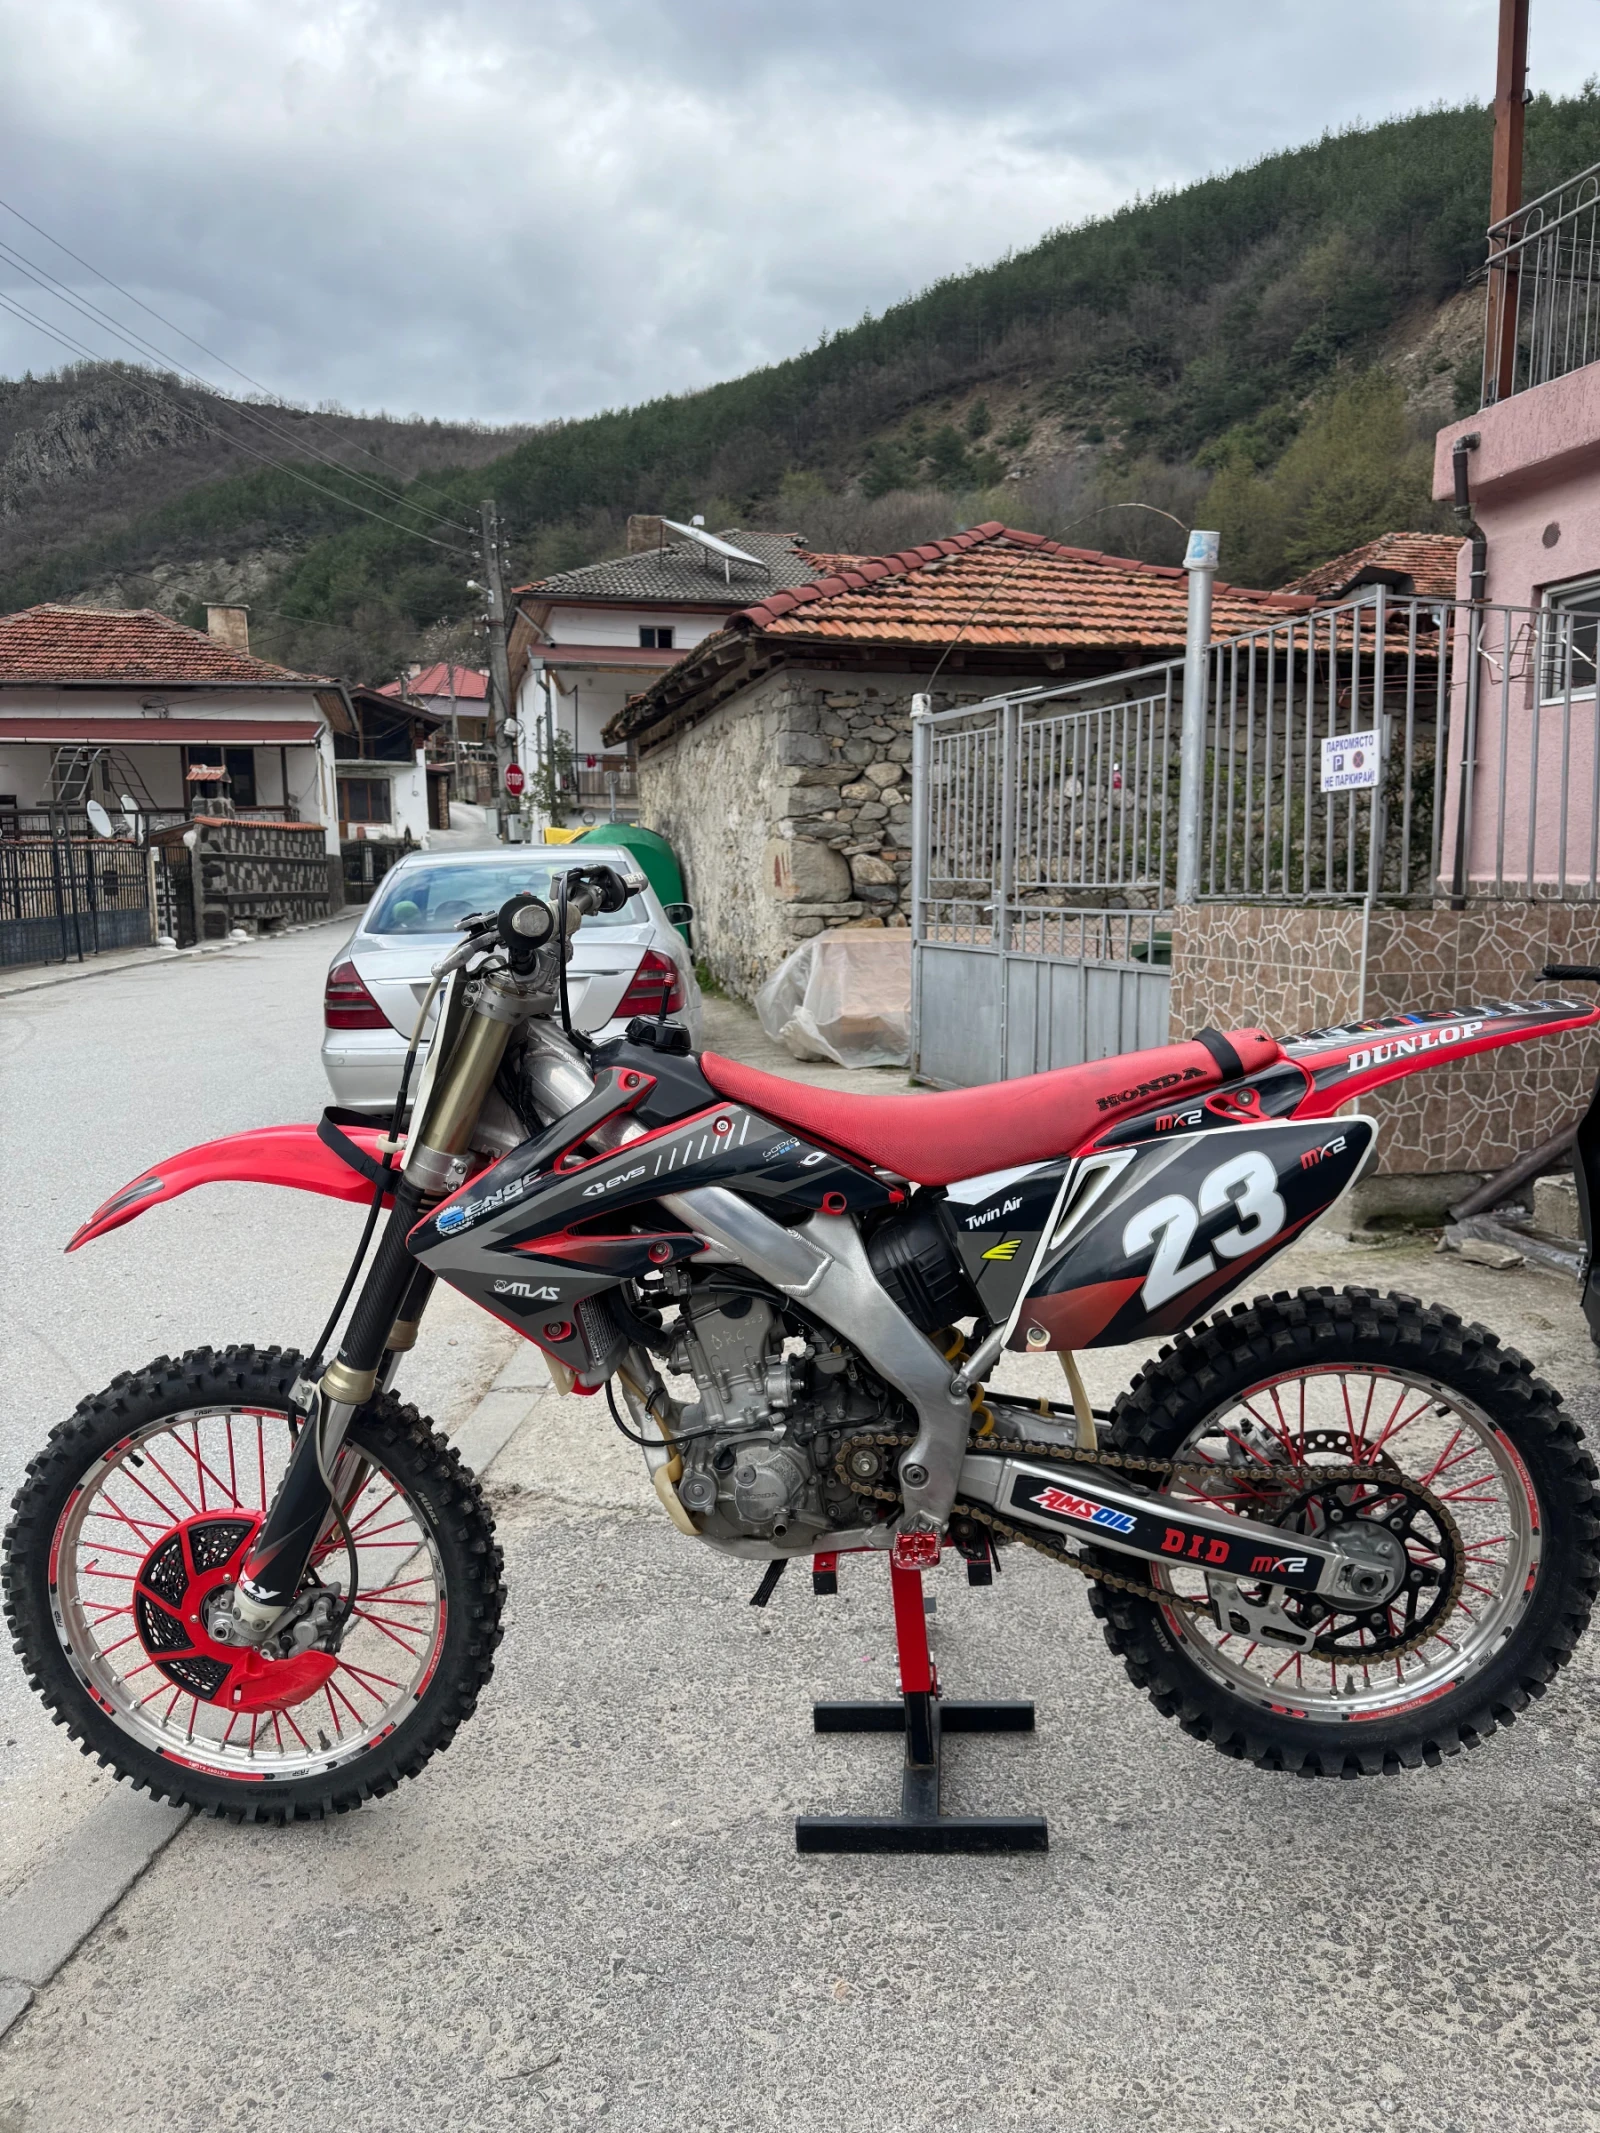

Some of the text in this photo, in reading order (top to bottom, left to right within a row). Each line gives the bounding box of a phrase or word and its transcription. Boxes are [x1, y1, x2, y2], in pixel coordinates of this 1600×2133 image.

[1326, 735, 1374, 753] ПАРКОМЯСТО
[507, 773, 522, 785] STOP
[1325, 776, 1334, 788] НЕ
[1347, 1021, 1484, 1074] DUNLOP
[1096, 1067, 1207, 1112] HONDA
[1155, 1109, 1202, 1132] MX2
[1300, 1136, 1347, 1170] MX2
[965, 1197, 1023, 1230] Twin Air
[1122, 1150, 1287, 1313] 23
[502, 1281, 560, 1300] ATLAS
[1278, 1366, 1325, 1380] FACTORY RACING
[742, 1492, 780, 1501] HONDA
[1516, 1460, 1534, 1501] FACTORY RACING
[415, 1490, 439, 1525] Mitas
[1031, 1487, 1137, 1534] AMSOIL
[53, 1512, 68, 1551] FACTORY RACING
[1161, 1528, 1230, 1563] D.I.D
[1250, 1556, 1308, 1574] MX2
[1151, 1617, 1175, 1652] Mitas
[429, 1633, 444, 1673] FACTORY RACING
[1378, 1699, 1422, 1717] FACTORY RACING
[207, 1767, 229, 1777] FACTORY
